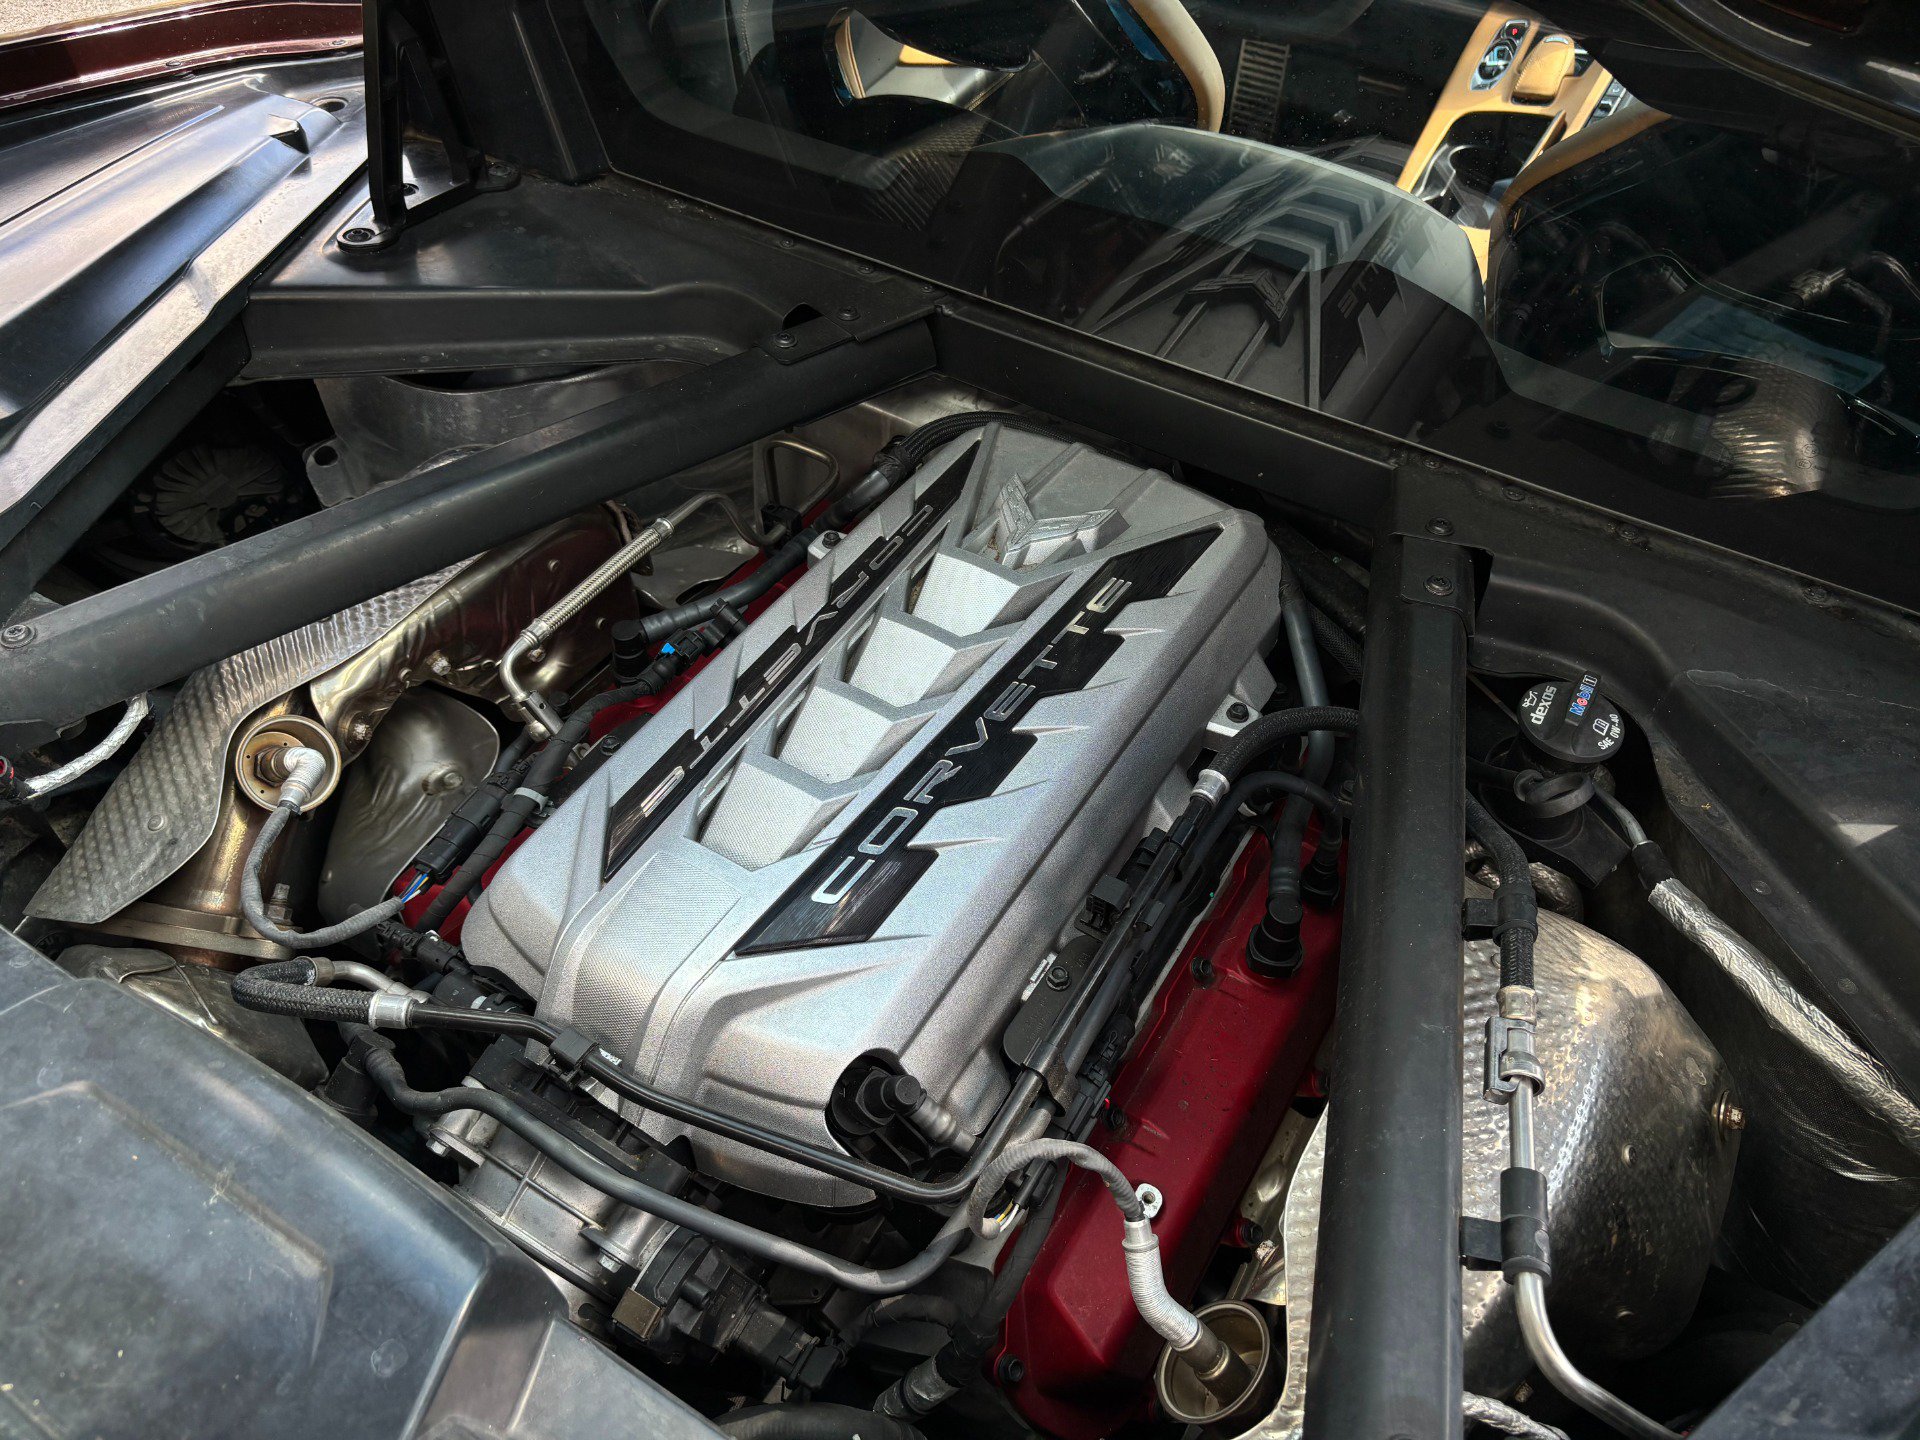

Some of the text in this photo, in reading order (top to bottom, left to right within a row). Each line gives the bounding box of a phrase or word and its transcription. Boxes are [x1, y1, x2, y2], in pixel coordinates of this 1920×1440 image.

[641, 504, 935, 818] CORVETTE
[1530, 686, 1557, 725] dexos
[1569, 684, 1594, 716] Mobil
[811, 577, 1132, 906] CORVETTE
[1597, 713, 1621, 750] SAE 0W-40
